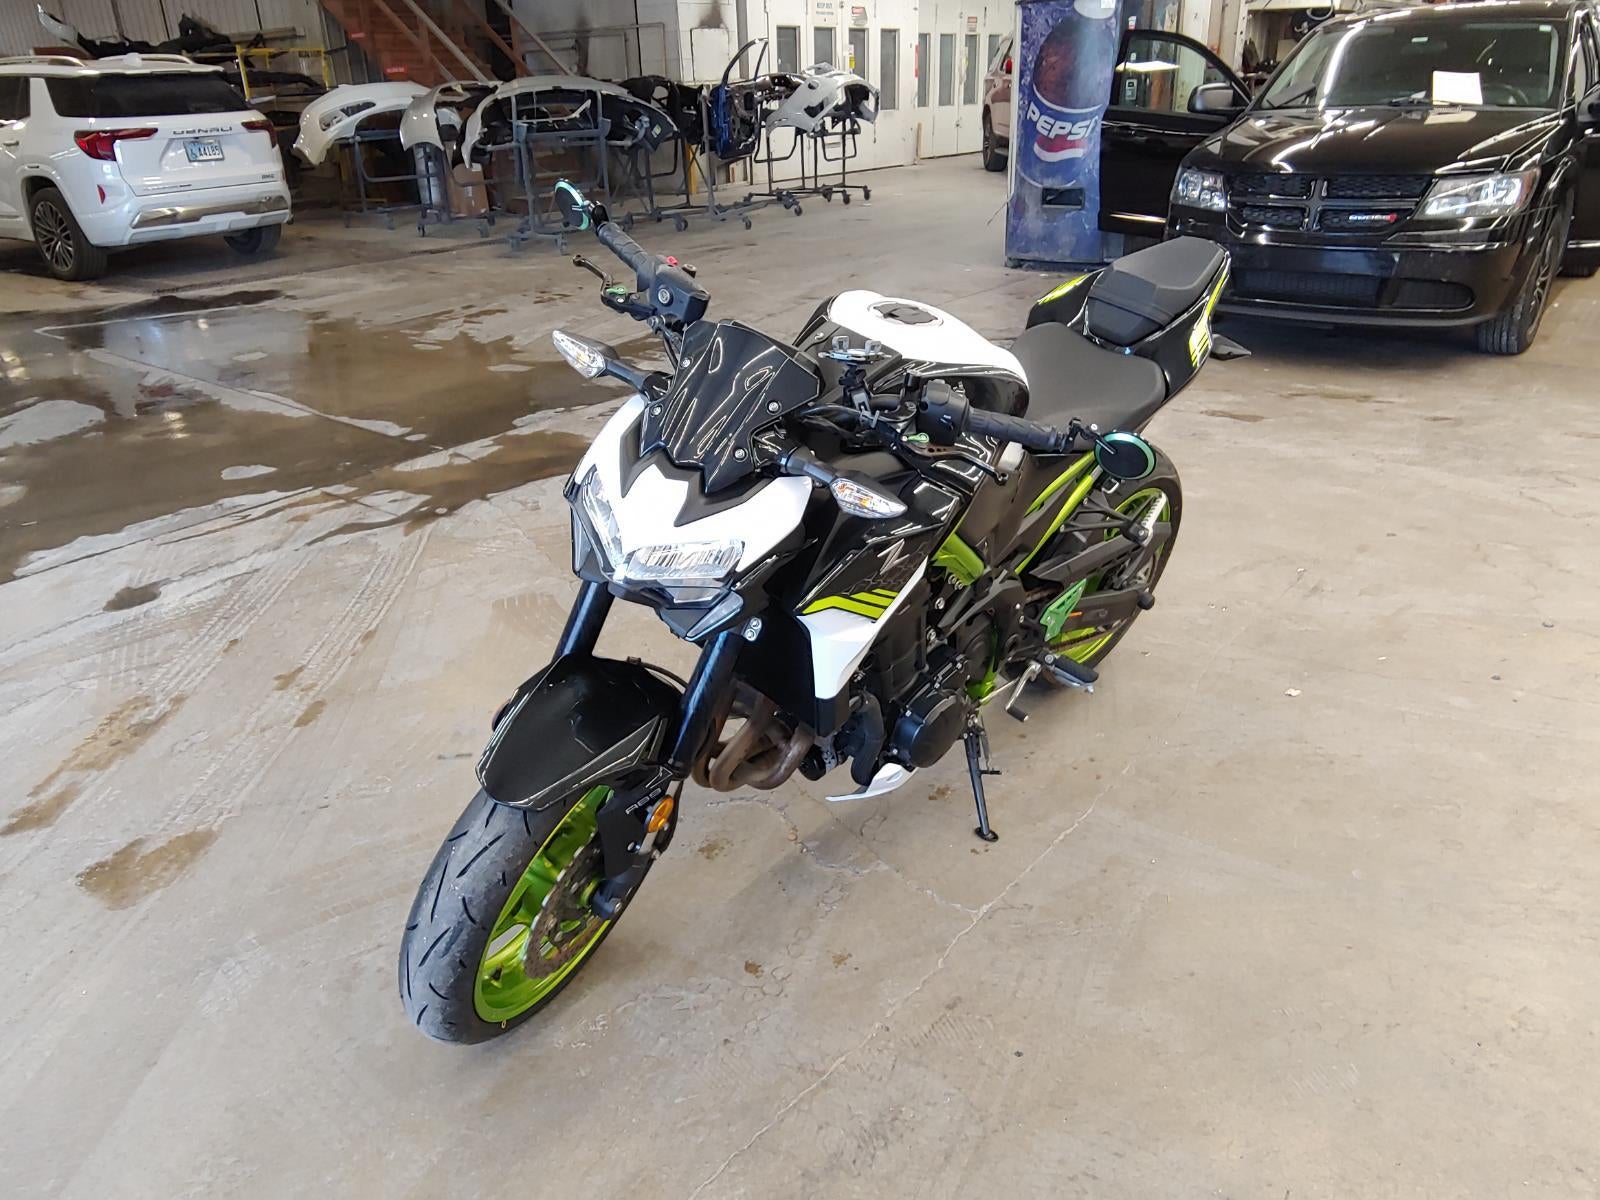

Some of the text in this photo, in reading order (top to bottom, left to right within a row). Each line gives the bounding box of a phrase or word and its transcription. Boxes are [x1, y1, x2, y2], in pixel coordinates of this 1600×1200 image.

[172, 126, 233, 135] DENALI
[1026, 101, 1099, 140] PEPSI
[625, 788, 662, 815] ABS
